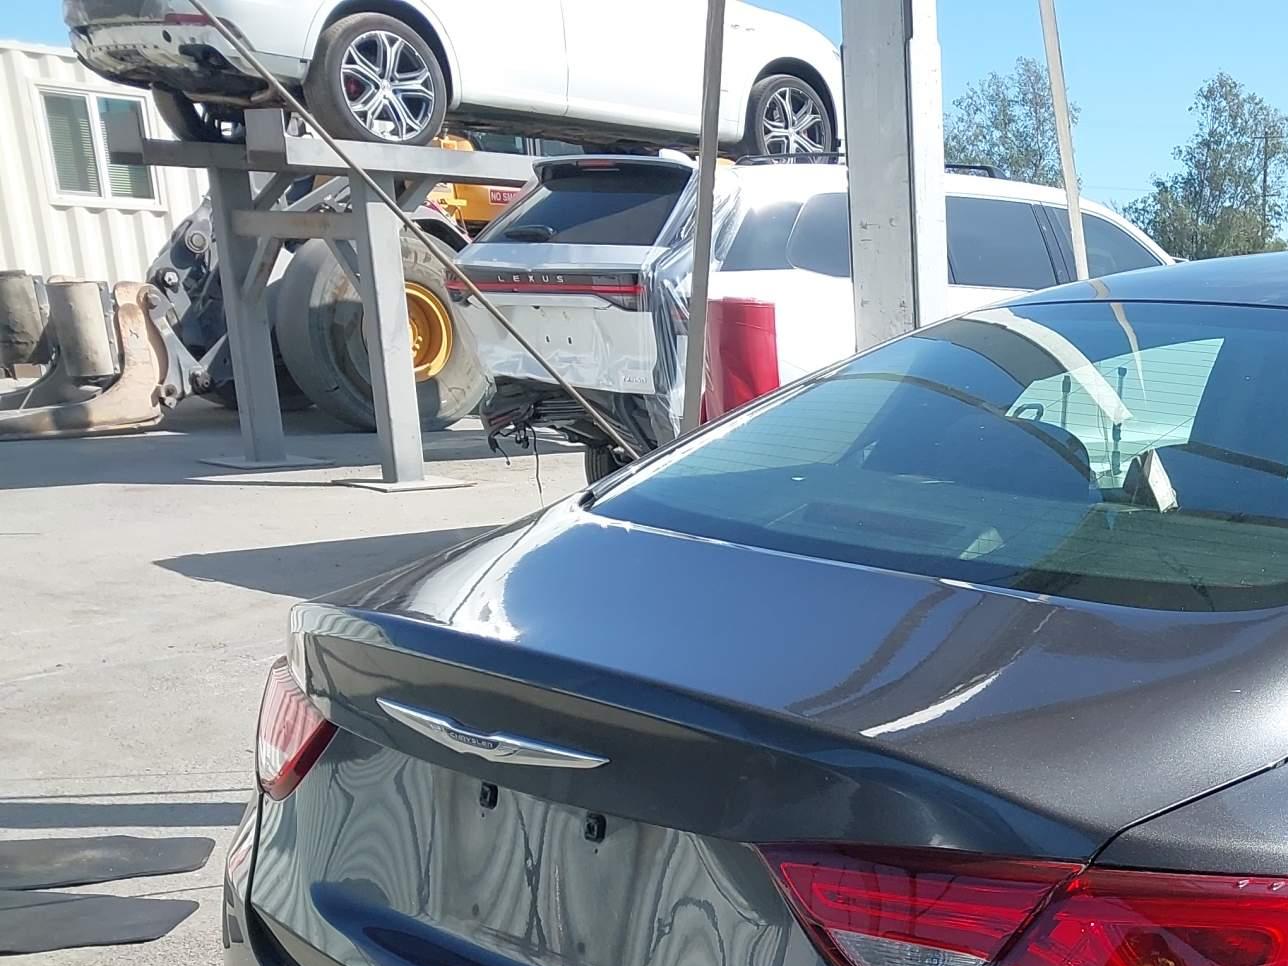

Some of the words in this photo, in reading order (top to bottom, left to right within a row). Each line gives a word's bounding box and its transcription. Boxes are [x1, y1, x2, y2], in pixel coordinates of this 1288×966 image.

[490, 191, 502, 202] NO
[497, 274, 564, 283] LEXUS
[449, 731, 494, 749] CHRYSLER
